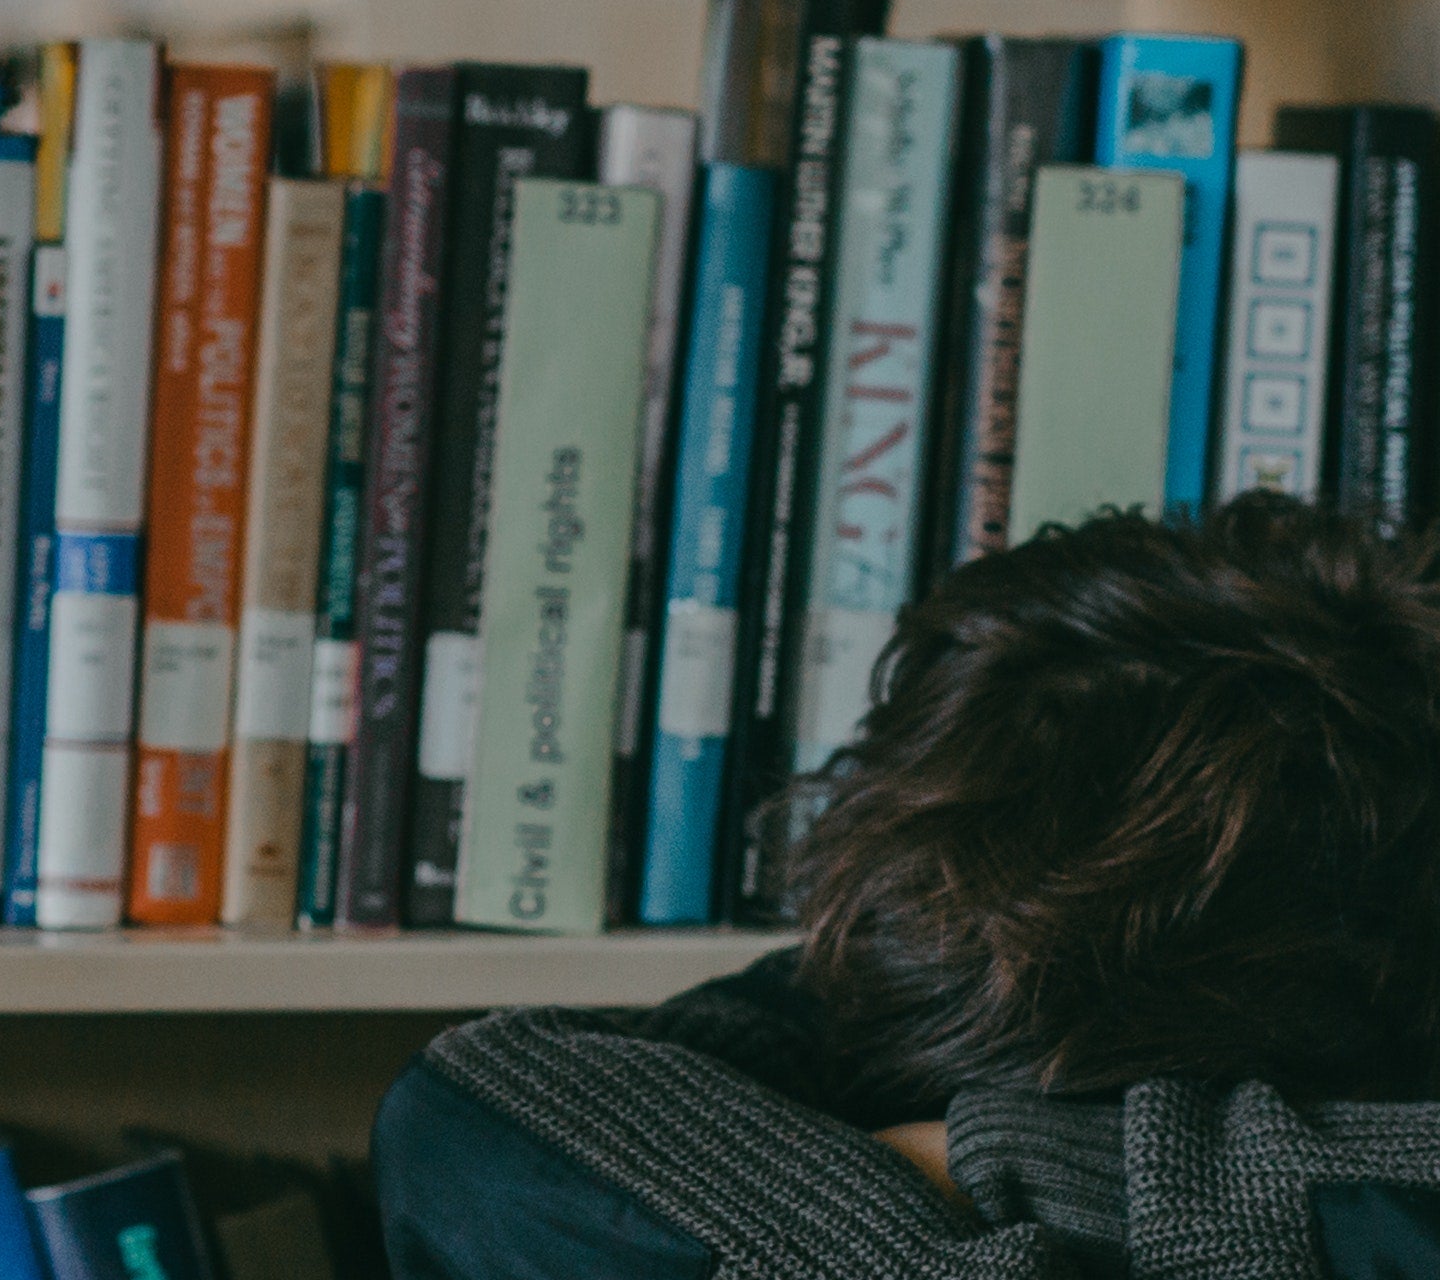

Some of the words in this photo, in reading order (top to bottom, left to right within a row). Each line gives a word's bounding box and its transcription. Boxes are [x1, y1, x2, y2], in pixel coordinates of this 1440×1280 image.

[207, 93, 264, 248] WOMEN
[189, 322, 244, 492] POLITICS
[833, 319, 918, 546] KING
[535, 446, 584, 575] rights
[522, 588, 570, 764] political
[515, 778, 557, 809] &
[508, 823, 554, 921] Civil
